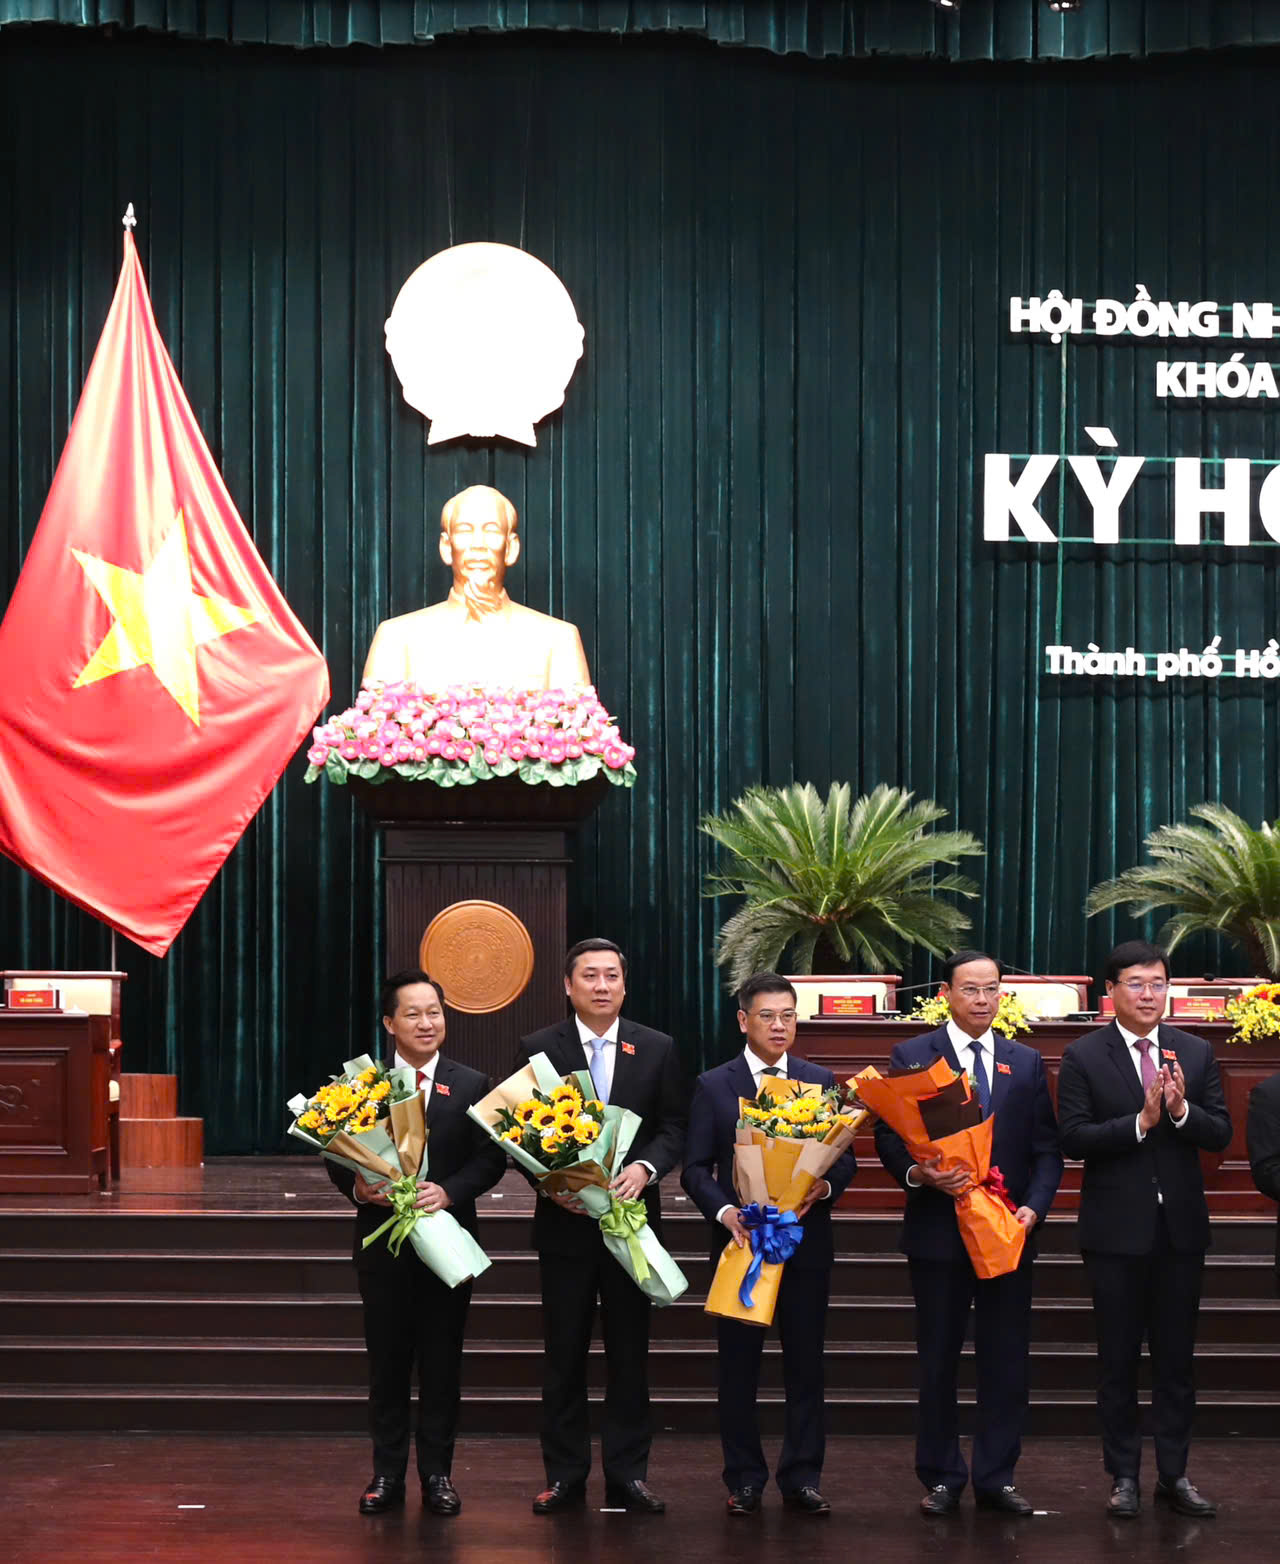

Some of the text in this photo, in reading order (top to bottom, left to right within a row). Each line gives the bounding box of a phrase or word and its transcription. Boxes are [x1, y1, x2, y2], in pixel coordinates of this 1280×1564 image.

[1010, 289, 1083, 344] HỘI
[1092, 283, 1220, 338] ĐỒNG
[1156, 352, 1280, 399] KHÓA
[983, 426, 1147, 544] KỲ
[1045, 643, 1147, 677] Thành
[1156, 635, 1223, 682] phố
